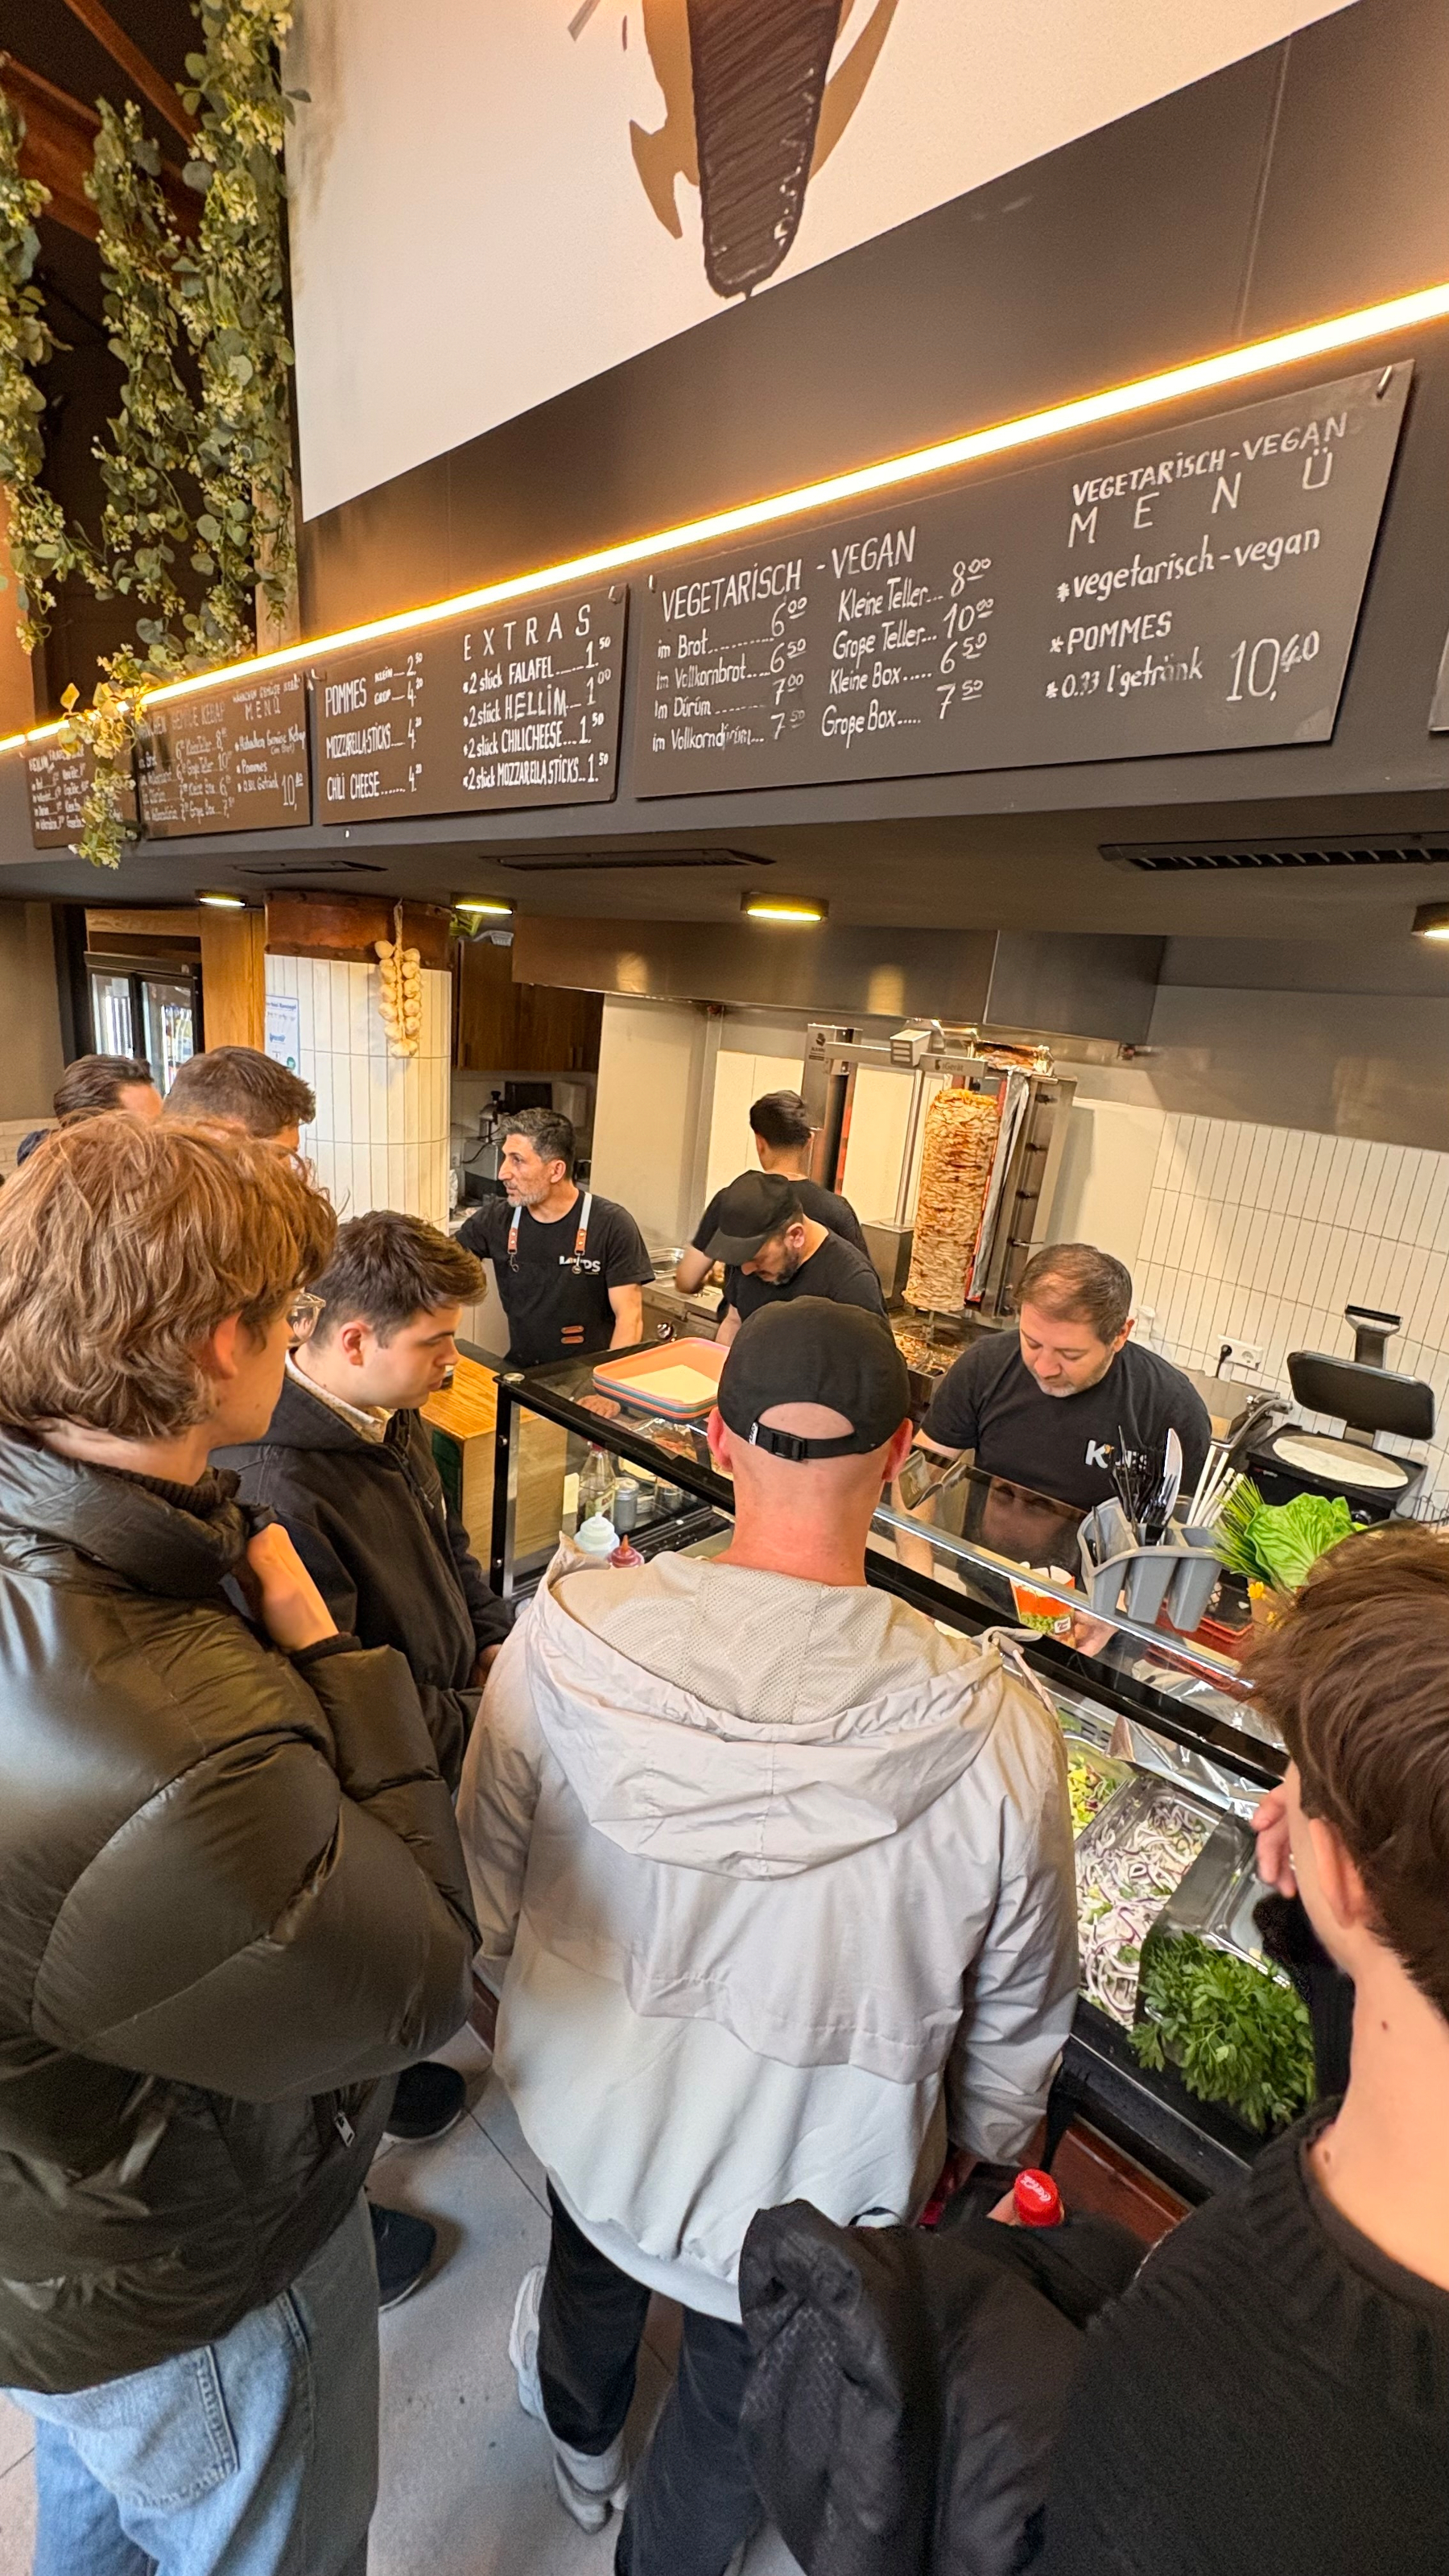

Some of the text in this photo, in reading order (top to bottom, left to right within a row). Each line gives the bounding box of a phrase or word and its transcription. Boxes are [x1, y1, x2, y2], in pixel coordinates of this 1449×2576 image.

[832, 526, 916, 579] VEGAN
[1073, 528, 1320, 601] vegetarisch-vegan
[838, 587, 884, 622] Kleine
[886, 576, 928, 612] Teller
[464, 604, 591, 662] EXTRAS
[658, 638, 671, 659] im
[678, 628, 708, 658] Brot
[881, 618, 926, 651] Teller
[1067, 611, 1172, 654] POMMES
[509, 655, 554, 685] FALAFEL
[656, 671, 669, 691] im
[829, 667, 868, 695] Kleine
[871, 661, 902, 688] Box
[325, 677, 366, 718] POMMES
[867, 699, 897, 731] Box
[652, 733, 665, 752] im
[350, 770, 380, 799] CHEESE
